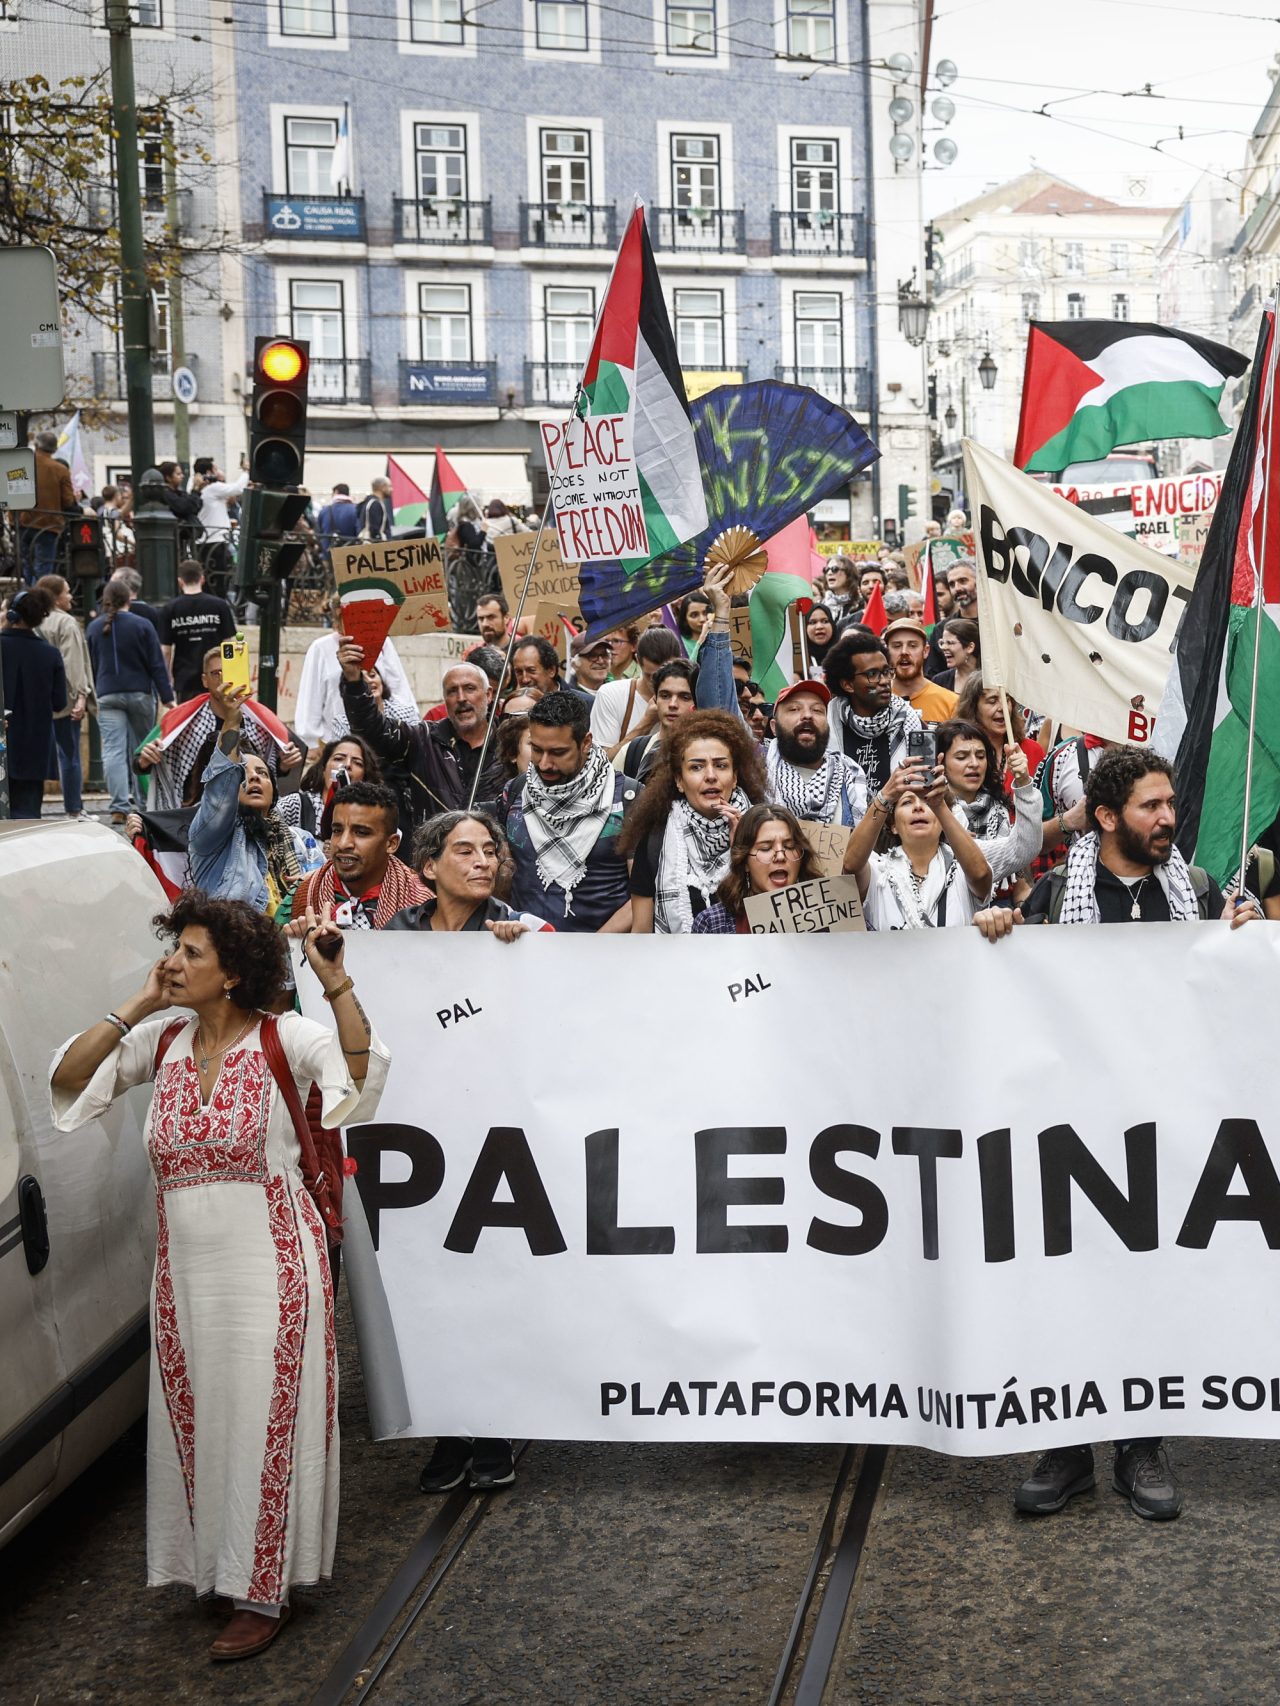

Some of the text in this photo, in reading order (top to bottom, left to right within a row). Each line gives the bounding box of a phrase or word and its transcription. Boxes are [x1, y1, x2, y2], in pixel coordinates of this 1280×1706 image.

[40, 323, 59, 332] CML
[542, 417, 631, 470] PEACE
[551, 469, 629, 490] DOES NOT
[555, 488, 638, 509] COME WITHOUT
[1113, 475, 1222, 517] ENOCÍDI
[556, 504, 649, 559] FREEDOM
[1135, 521, 1170, 535] SRAEL
[512, 539, 560, 556] WE CA
[514, 562, 543, 579] STOP
[514, 575, 580, 599] GENOCIDE
[770, 879, 837, 918] FREE
[727, 973, 772, 1002] PAL
[436, 997, 482, 1029] PAL
[600, 1381, 908, 1418] PLATAFORMA
[918, 1376, 1107, 1430] UNITÁRIA
[1122, 1375, 1185, 1412] DE
